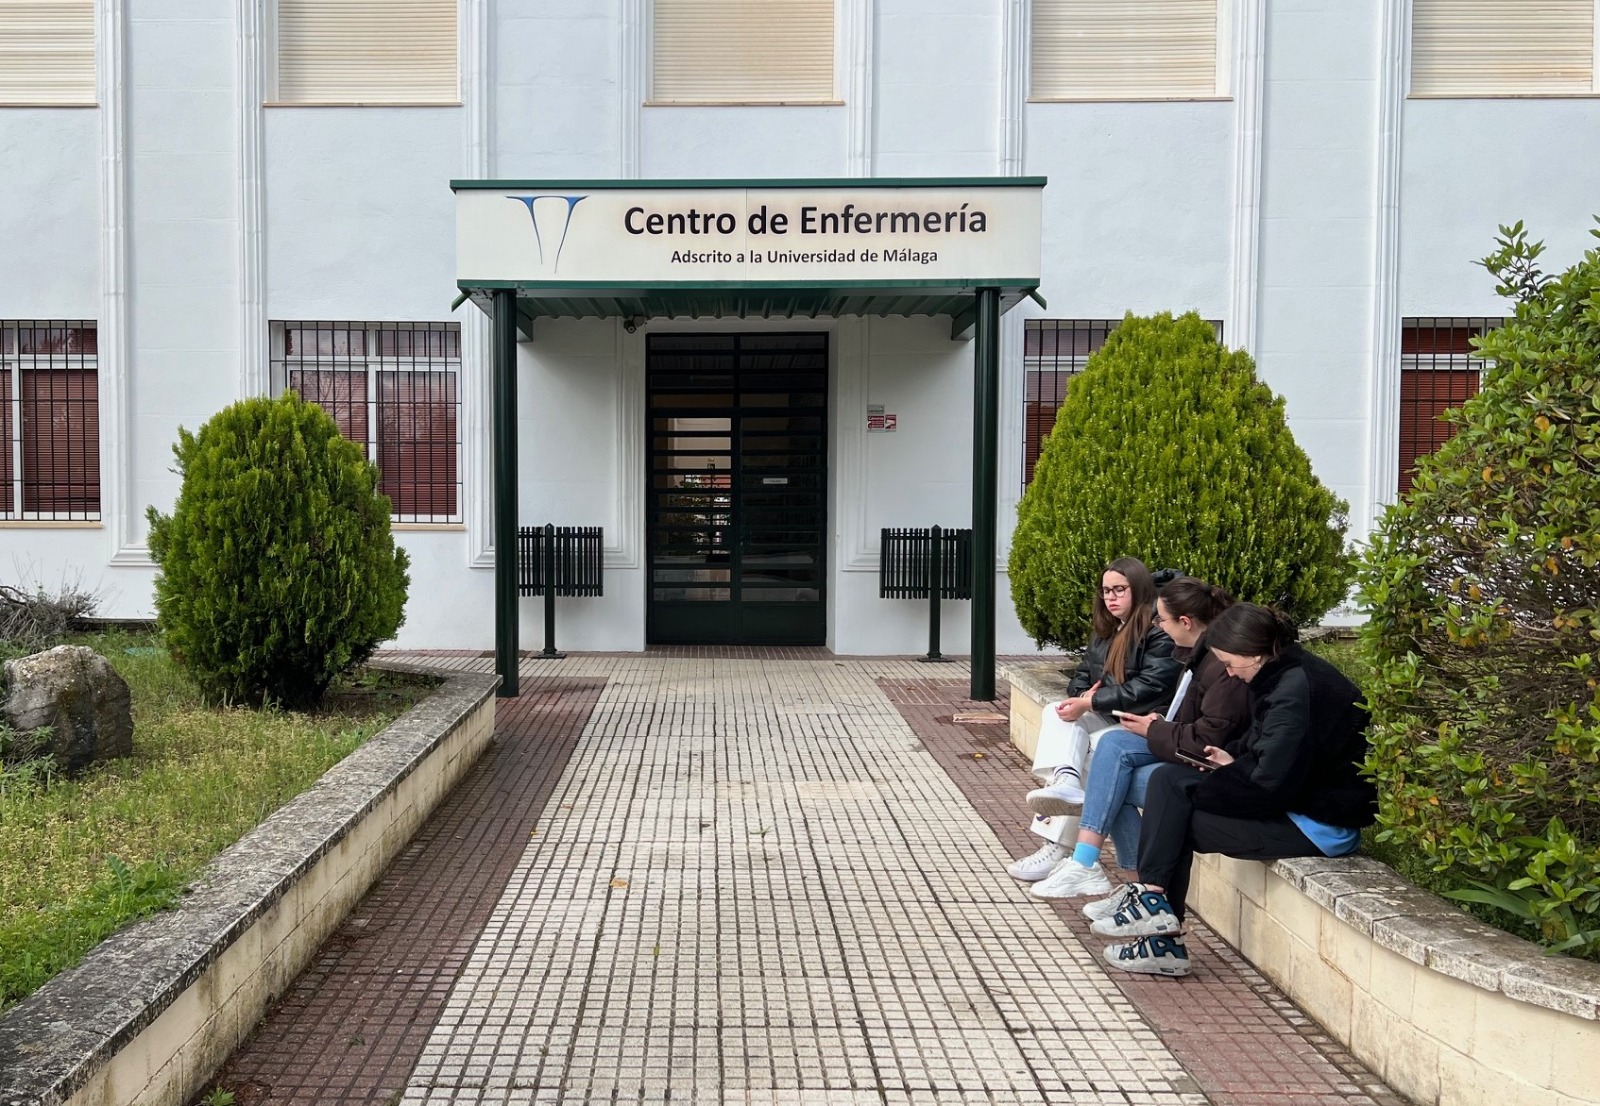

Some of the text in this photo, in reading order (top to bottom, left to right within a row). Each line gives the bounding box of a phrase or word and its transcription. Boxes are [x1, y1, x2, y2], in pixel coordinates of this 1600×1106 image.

[624, 202, 987, 235] Centro de Enfermería
[670, 247, 938, 265] Adscrito a la Universidad de Málaga
[1113, 891, 1175, 926] AIR
[1119, 935, 1189, 960] AIR
